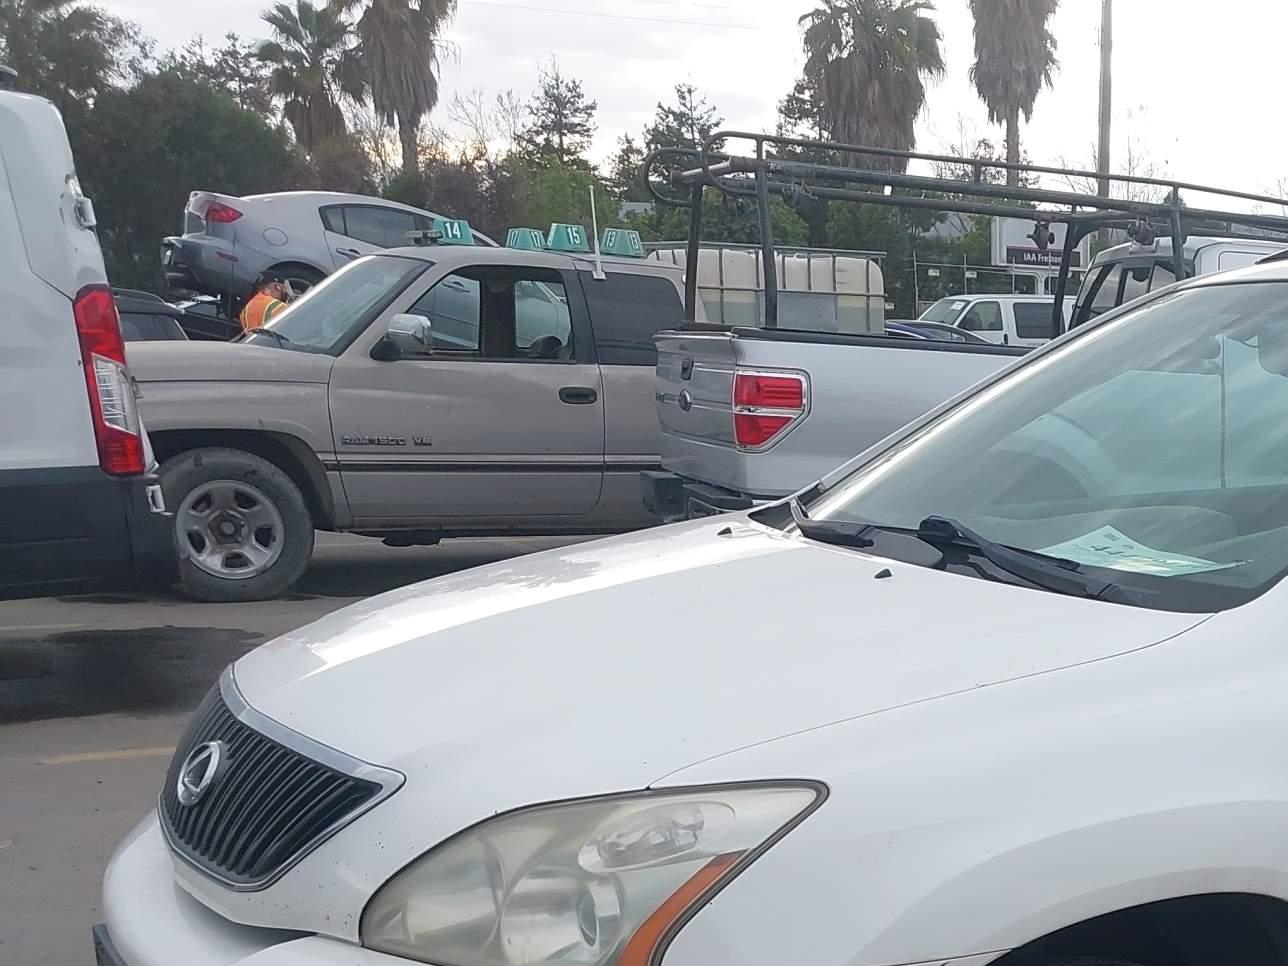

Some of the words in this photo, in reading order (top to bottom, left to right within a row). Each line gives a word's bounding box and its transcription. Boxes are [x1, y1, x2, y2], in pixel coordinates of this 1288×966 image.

[445, 221, 461, 239] 14
[567, 226, 580, 244] 15
[531, 231, 541, 247] 17
[606, 231, 616, 247] 13
[629, 233, 639, 249] 13
[1023, 252, 1037, 262] IAA
